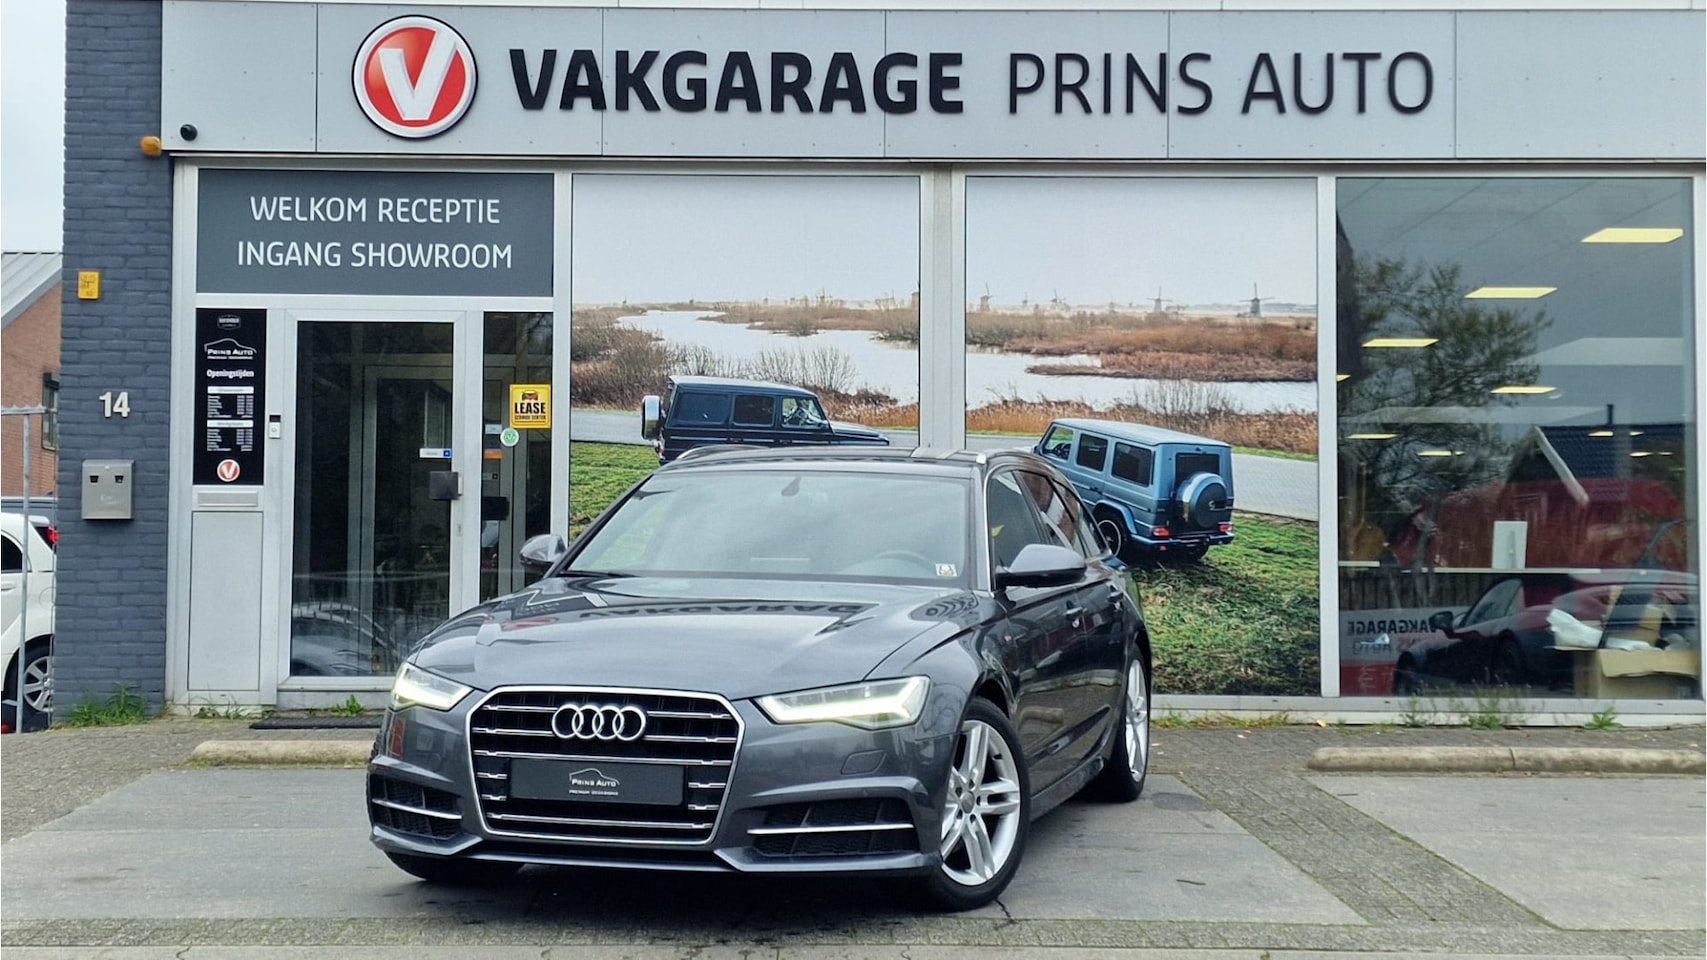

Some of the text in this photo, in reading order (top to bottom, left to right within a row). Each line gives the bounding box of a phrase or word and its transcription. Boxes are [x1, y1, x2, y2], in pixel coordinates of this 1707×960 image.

[510, 49, 1434, 115] VAKGARAGE PRINS AUTO
[250, 196, 500, 224] WELKOM RECEPTIE
[238, 241, 512, 269] INGANG SHOWROOM
[206, 369, 255, 379] Openingstijden
[99, 391, 130, 418] 14
[514, 402, 546, 414] LEASE
